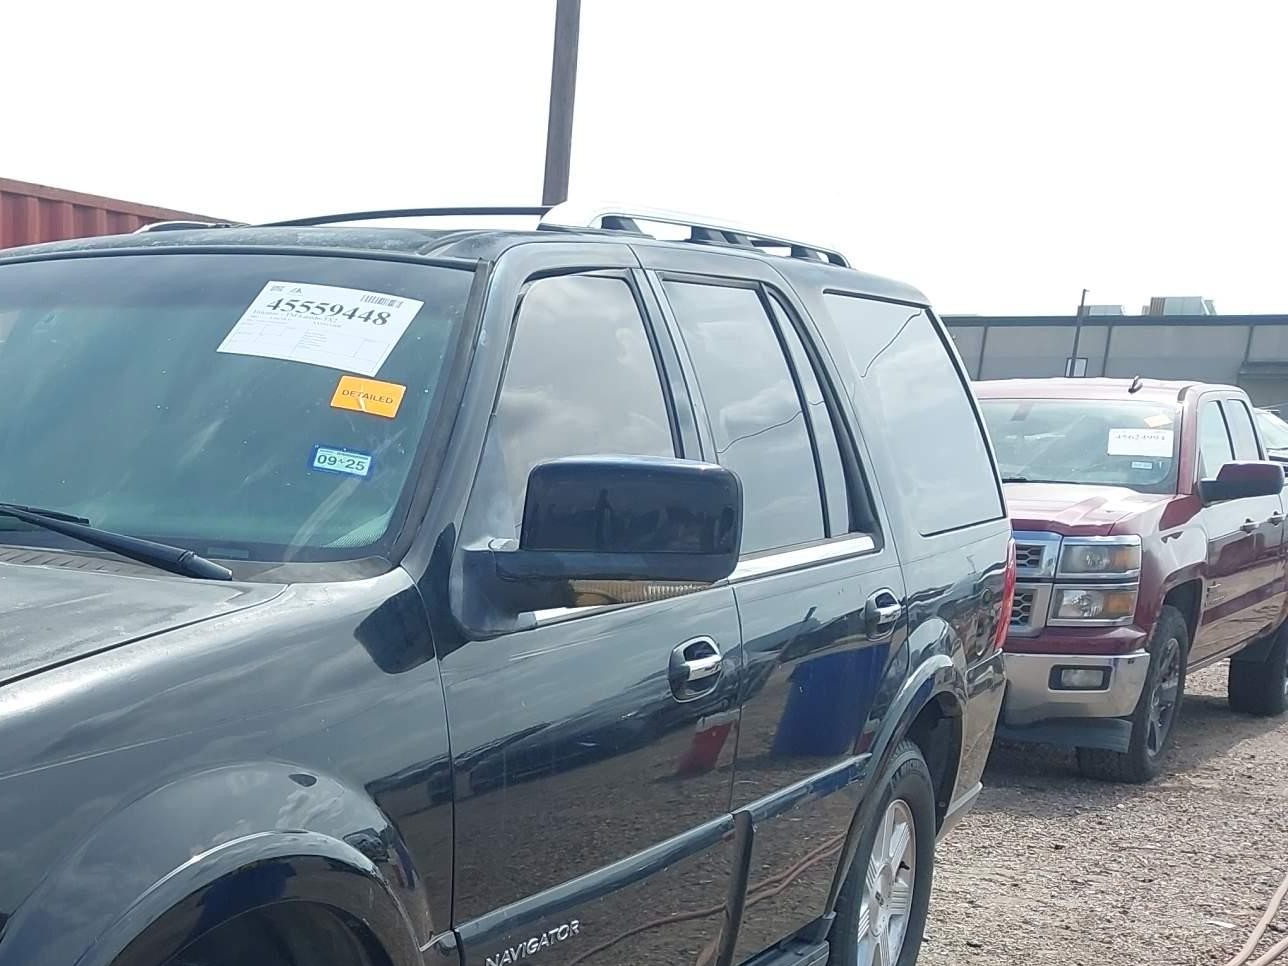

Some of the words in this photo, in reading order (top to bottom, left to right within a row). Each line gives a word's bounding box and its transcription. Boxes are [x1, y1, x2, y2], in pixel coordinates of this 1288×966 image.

[266, 297, 392, 326] 45559448
[341, 388, 394, 405] DETAILED
[317, 454, 337, 466] 09
[344, 459, 365, 471] 25
